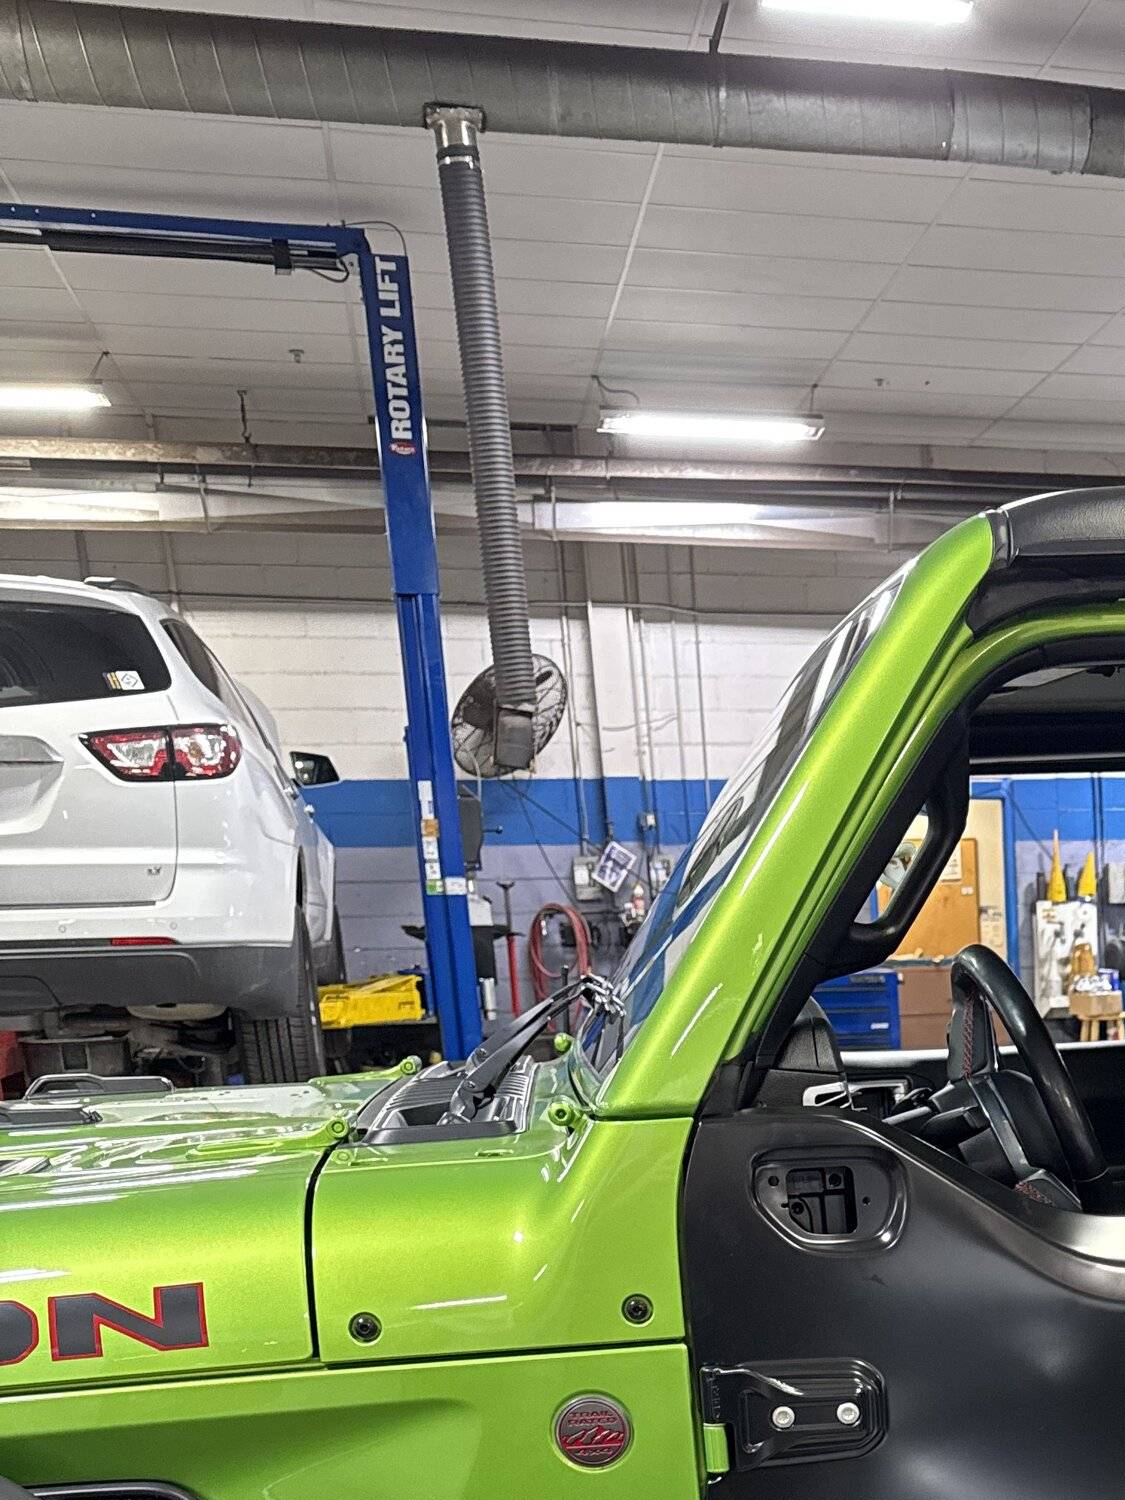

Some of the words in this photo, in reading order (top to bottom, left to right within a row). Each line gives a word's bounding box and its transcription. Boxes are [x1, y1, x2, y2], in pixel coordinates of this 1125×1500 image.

[375, 256, 401, 318] LIFT
[381, 324, 413, 440] ROTARY
[568, 1410, 614, 1419] TRAIL
